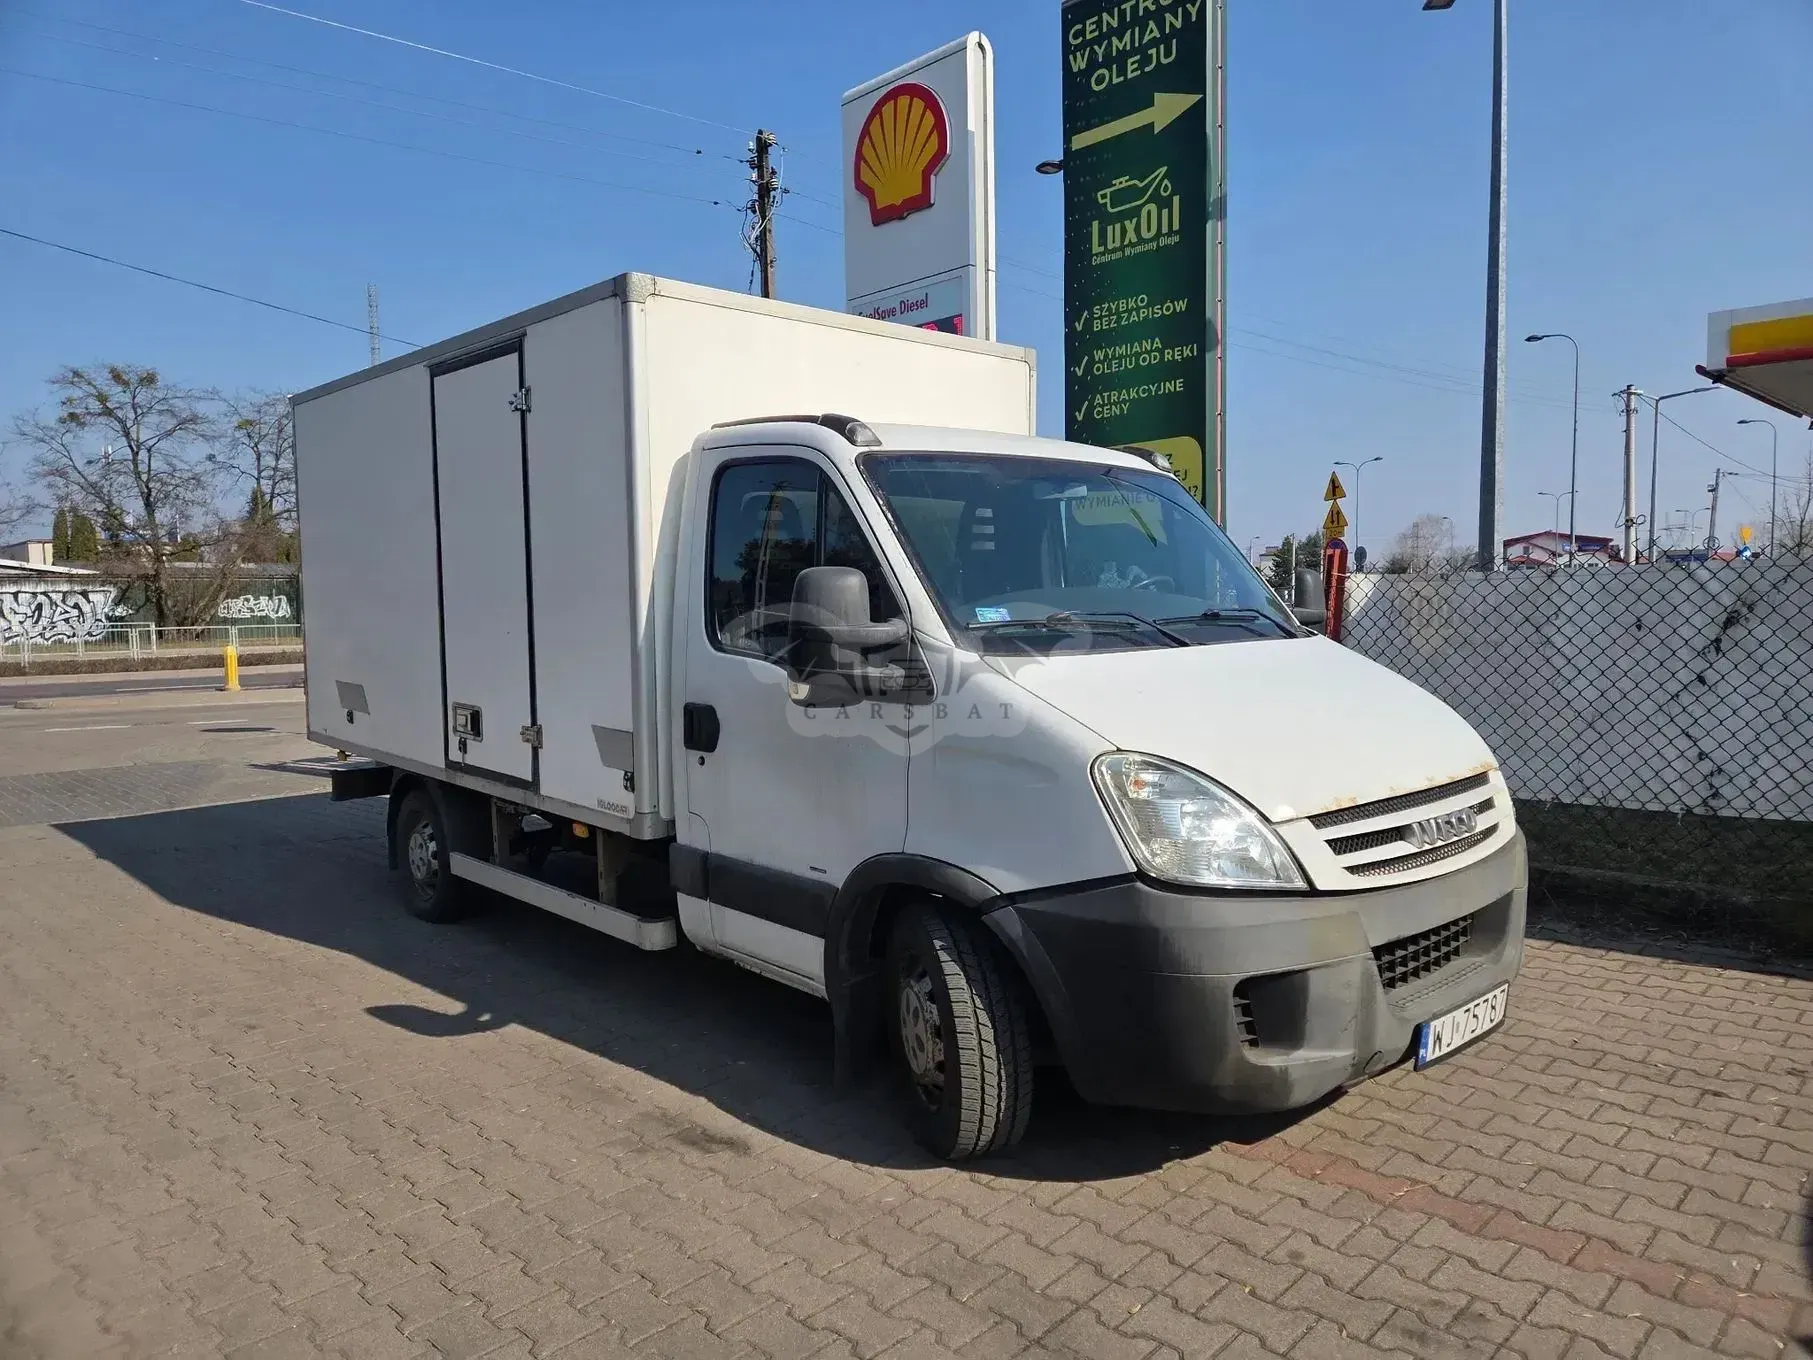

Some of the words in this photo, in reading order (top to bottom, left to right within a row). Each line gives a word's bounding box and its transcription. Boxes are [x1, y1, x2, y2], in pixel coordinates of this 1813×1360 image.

[1068, 0, 1174, 45] CENTR
[1069, 0, 1201, 73] WYMIANY
[1090, 38, 1177, 92] OLEJU
[1091, 194, 1180, 254] LuxOil
[1091, 250, 1123, 266] Centrum
[1124, 240, 1157, 258] Wymiany
[1159, 234, 1180, 247] Oleju
[899, 292, 928, 315] Diesel
[1093, 294, 1148, 318] SZYBKO
[1093, 316, 1117, 332] BEZ
[1120, 298, 1188, 325] ZAPISÓW
[1093, 337, 1162, 362] WYMIANA
[1093, 356, 1136, 376] OLEJU
[1139, 351, 1160, 366] OD
[1164, 343, 1198, 363] RĘKI
[1093, 378, 1184, 406] ATRAKCYJNE
[1093, 402, 1130, 419] CENY
[1407, 807, 1478, 849] IVECO
[1431, 1015, 1456, 1056] WJ
[1461, 988, 1506, 1041] 75787
